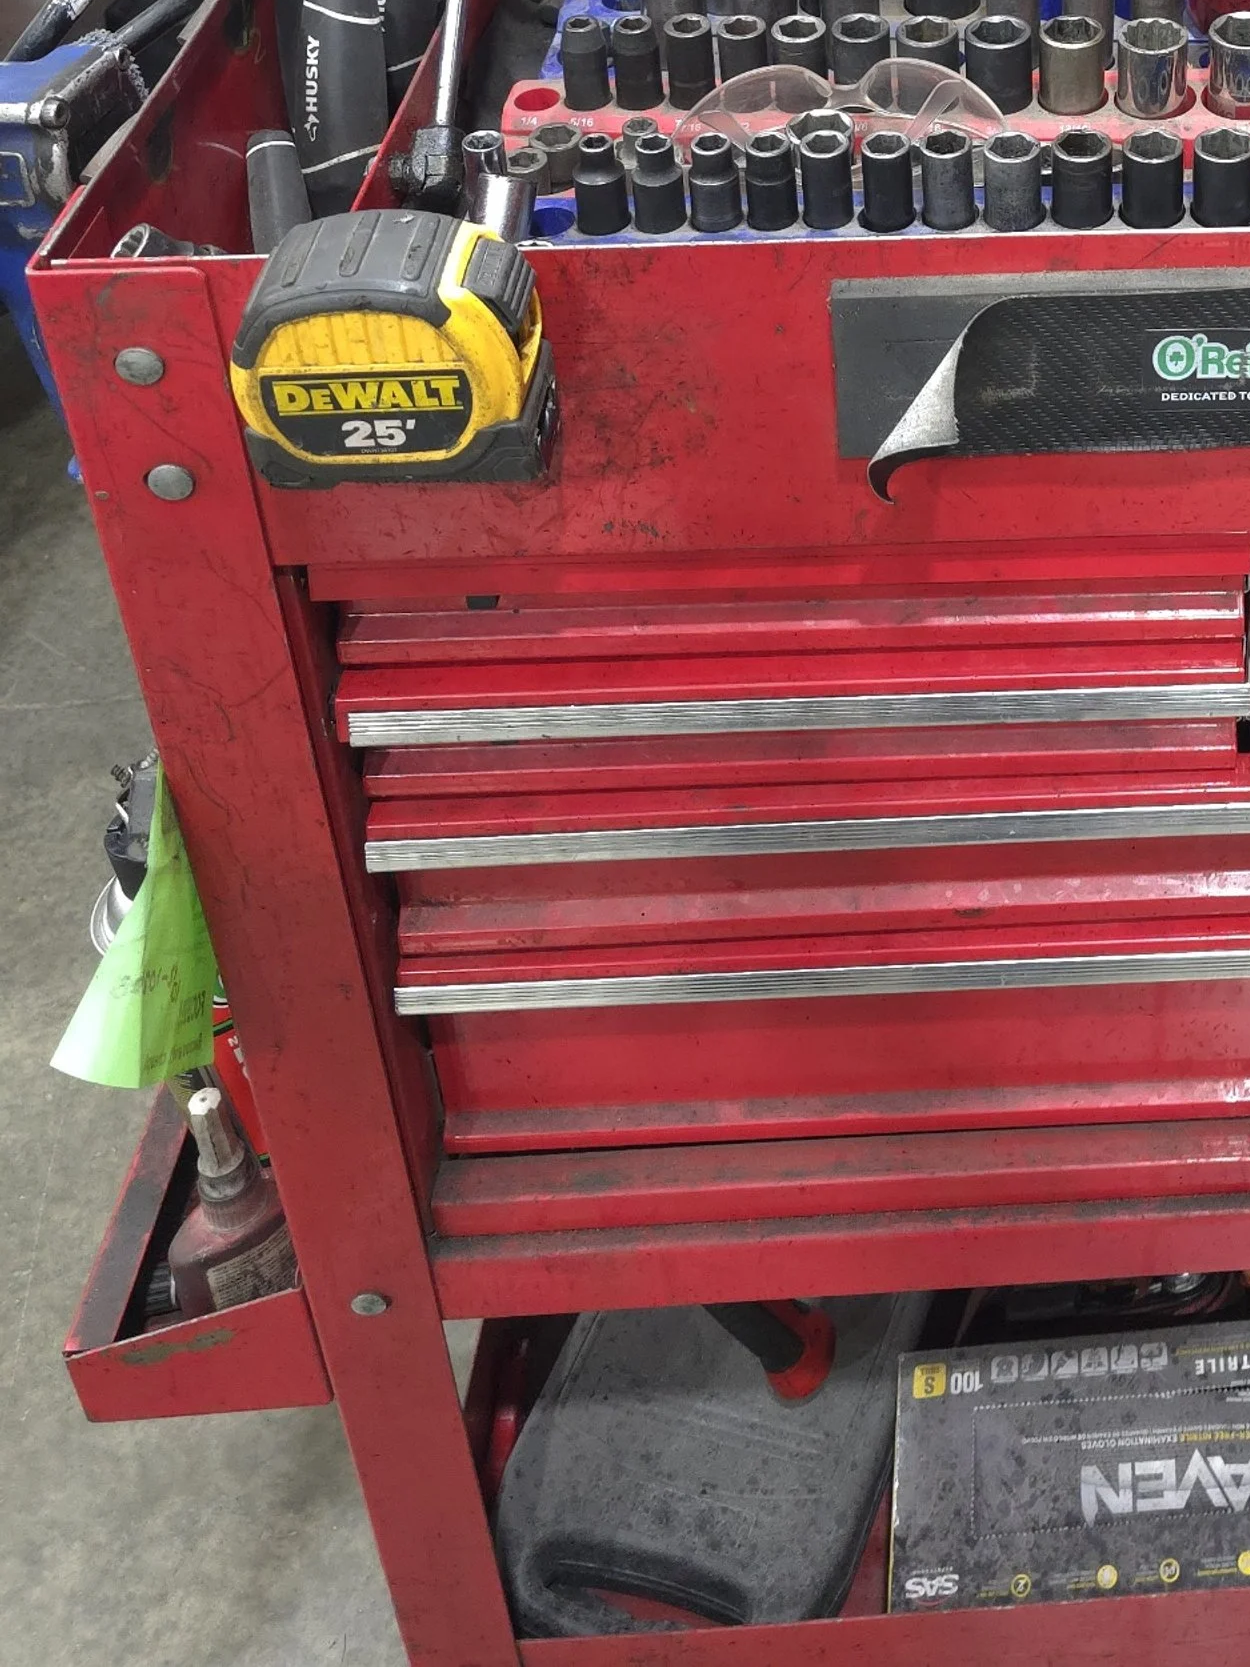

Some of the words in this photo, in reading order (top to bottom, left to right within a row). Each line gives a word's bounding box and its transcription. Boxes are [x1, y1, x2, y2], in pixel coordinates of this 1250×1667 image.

[305, 35, 321, 114] HUSKY
[519, 116, 539, 128] 1/4
[1161, 390, 1237, 402] DEDICATED
[340, 418, 417, 449] 25'
[924, 1376, 936, 1395] S
[950, 1370, 983, 1395] 100
[1081, 1438, 1116, 1450] GLOVES
[905, 1573, 960, 1600] SAS
